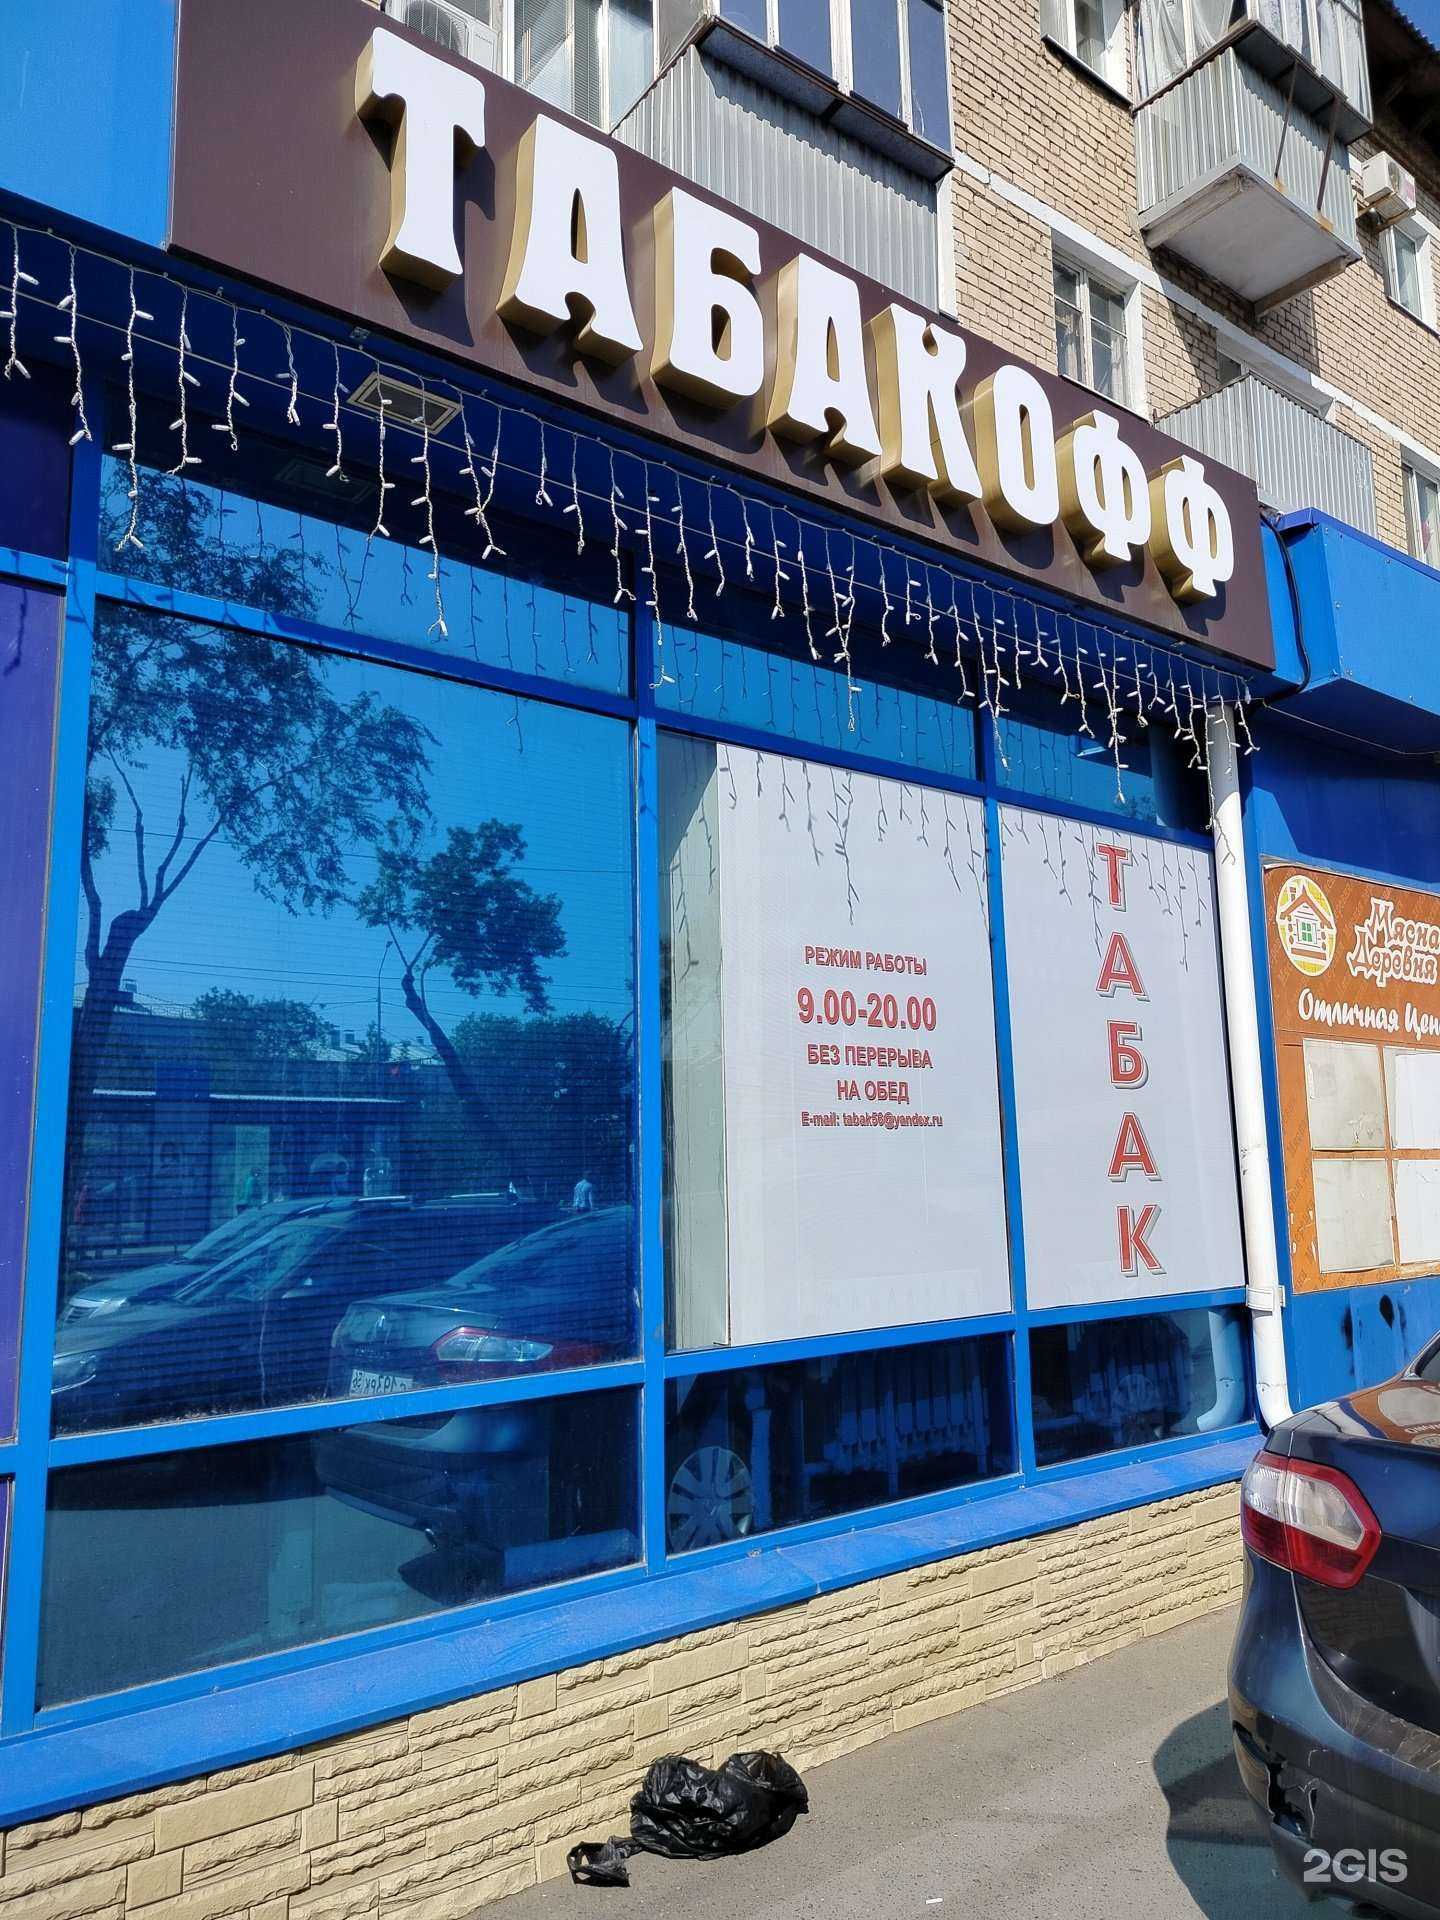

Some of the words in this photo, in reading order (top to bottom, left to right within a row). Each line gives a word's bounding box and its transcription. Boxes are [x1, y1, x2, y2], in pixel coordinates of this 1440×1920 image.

[355, 27, 1234, 600] ТАБАКОФФ
[1365, 897, 1440, 952] Мясна
[804, 945, 862, 969] РЕЖИМ
[865, 951, 928, 975] РАБОТЫ
[1347, 925, 1438, 987] Деревня
[797, 987, 937, 1031] 9.00-20.00
[1298, 988, 1399, 1032] Отличная
[1405, 1002, 1440, 1040] Цен
[807, 1043, 840, 1066] БЕЗ
[844, 1045, 934, 1069] ПЕРЕРЫВА
[1096, 842, 1166, 1276] ТАБАК
[837, 1079, 861, 1101] НА
[864, 1080, 910, 1105] ОБЕД
[801, 1111, 841, 1127] E-mail:
